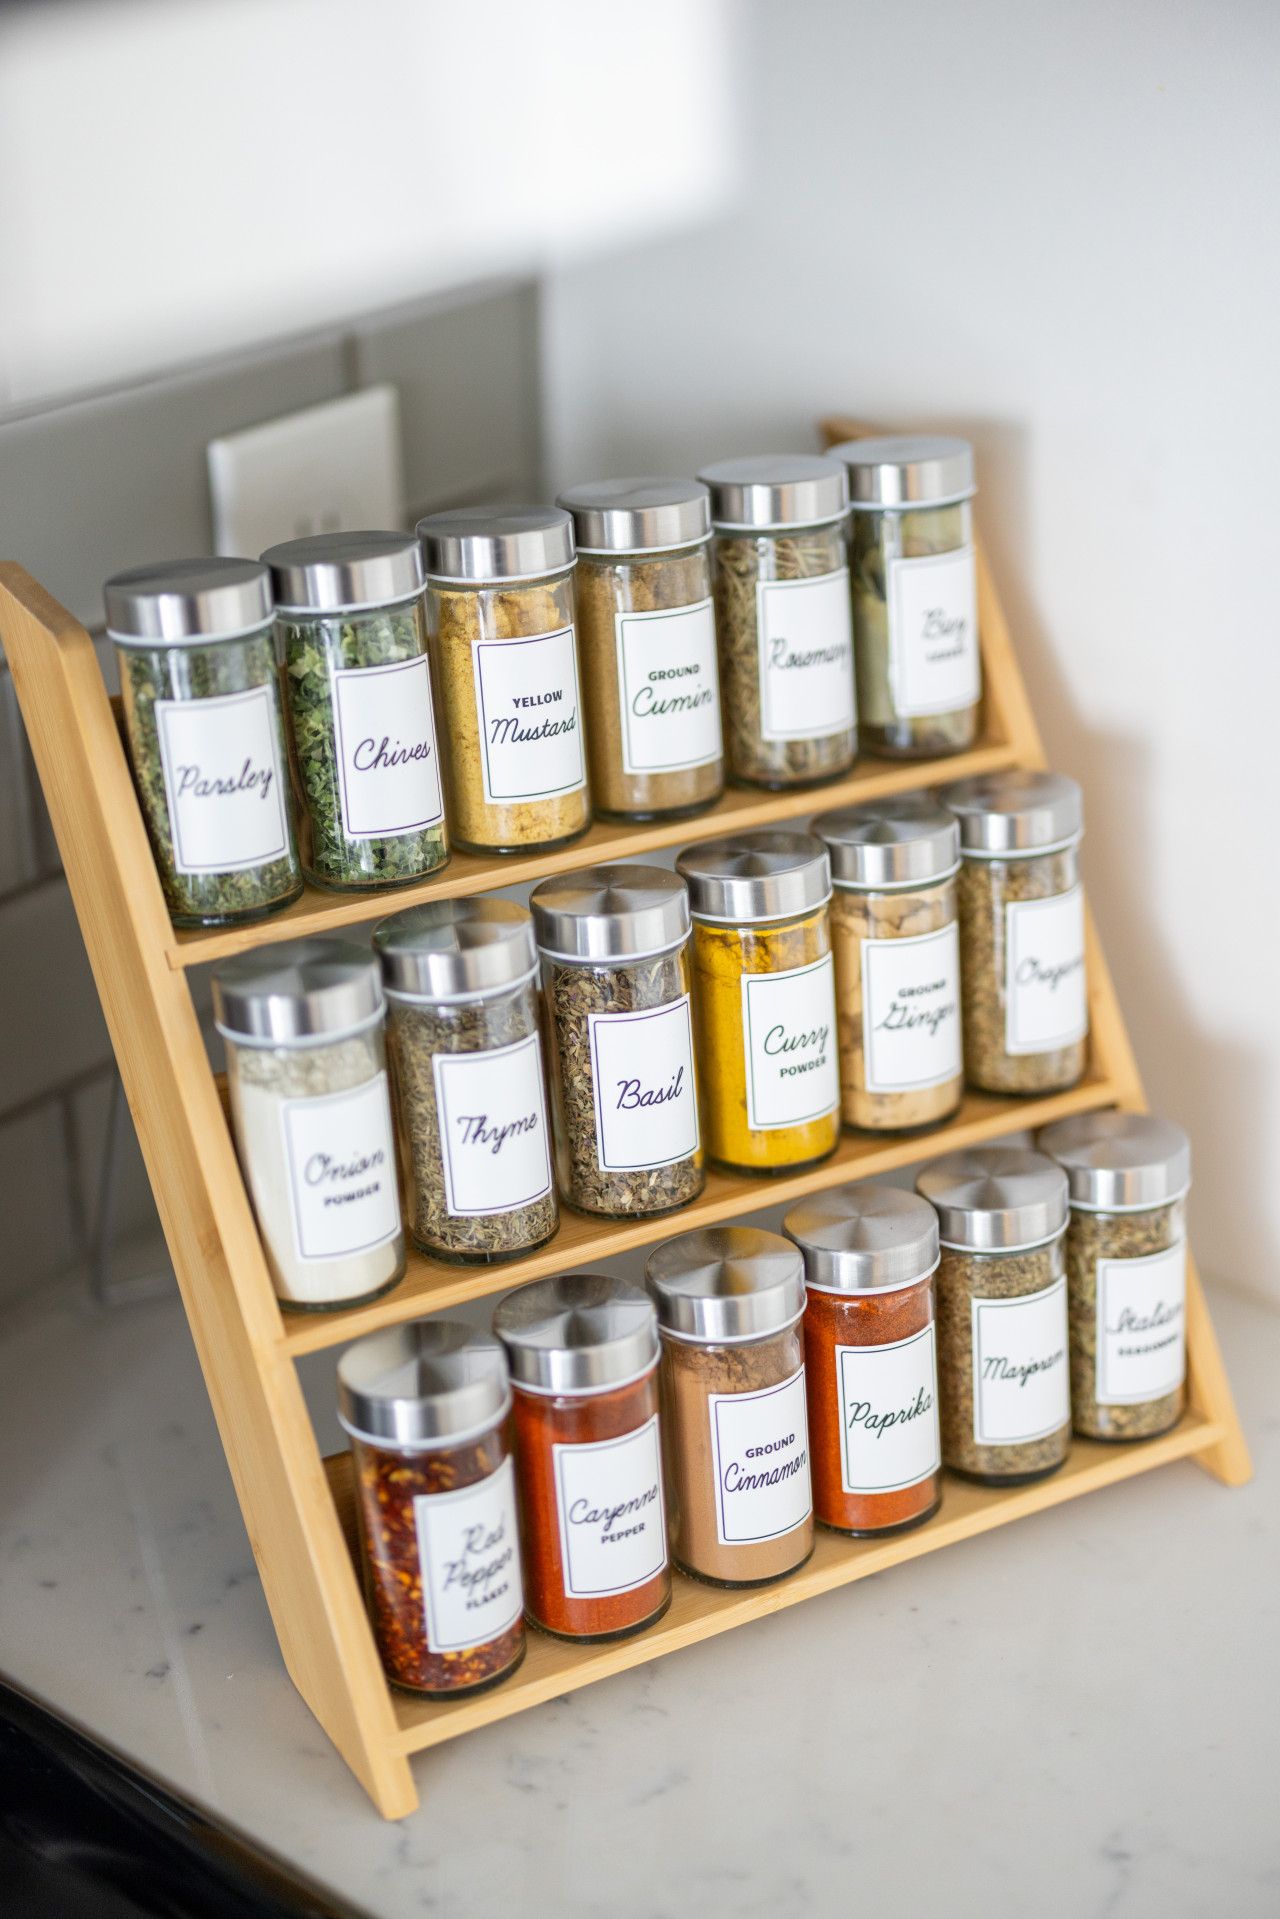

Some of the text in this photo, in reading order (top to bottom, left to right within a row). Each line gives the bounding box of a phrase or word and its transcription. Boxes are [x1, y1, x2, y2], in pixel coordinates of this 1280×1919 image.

[648, 664, 700, 681] GROUND
[512, 690, 563, 709] YELLOW
[632, 684, 713, 717] Cumin
[490, 705, 577, 744] Mustard
[353, 736, 432, 771] Chives
[175, 758, 273, 800] Parsley
[764, 1024, 830, 1056] Curry
[779, 1055, 827, 1078] POWDER
[616, 1066, 683, 1109] Basil
[457, 1111, 538, 1154] Thyme
[304, 1147, 385, 1186] Onion
[323, 1182, 381, 1207] POWDER
[848, 1386, 934, 1438] Paprika
[745, 1433, 796, 1459] GROUND
[724, 1450, 807, 1493] Cinnamon
[569, 1484, 658, 1531] Cayenne
[462, 1511, 505, 1558] Red
[600, 1522, 646, 1544] PEPPER
